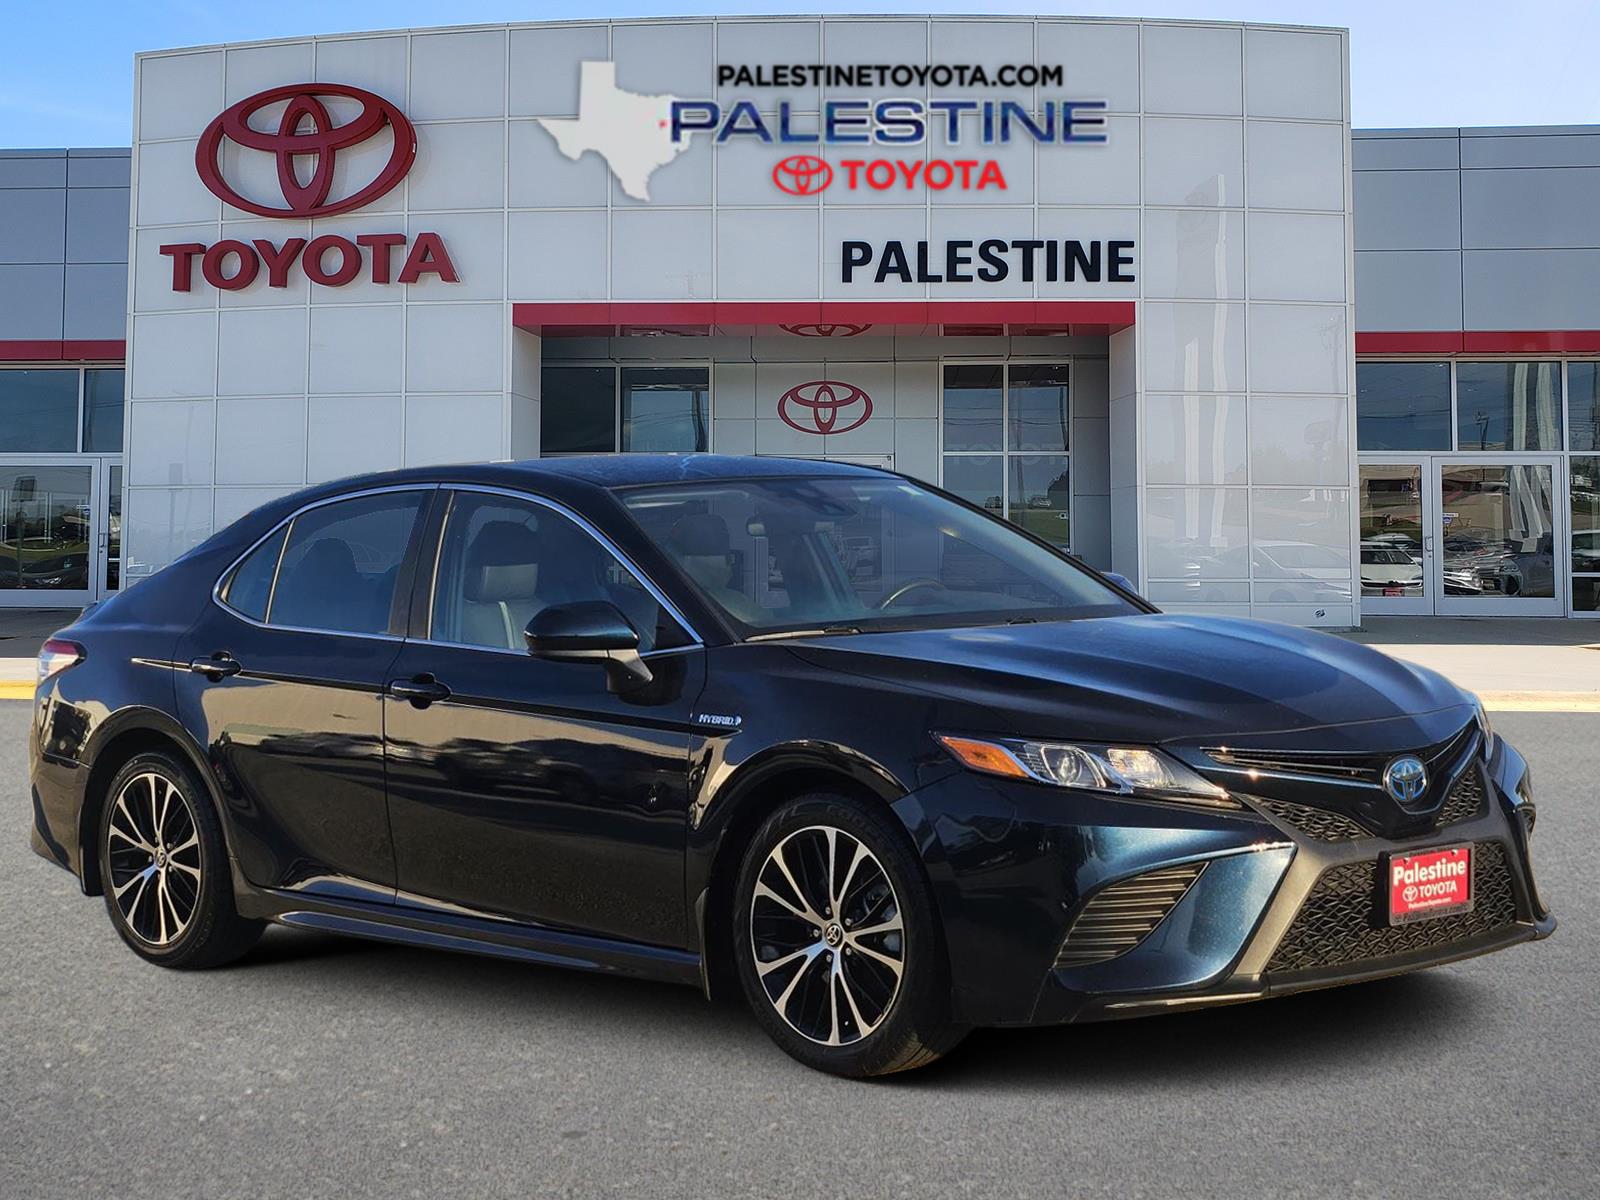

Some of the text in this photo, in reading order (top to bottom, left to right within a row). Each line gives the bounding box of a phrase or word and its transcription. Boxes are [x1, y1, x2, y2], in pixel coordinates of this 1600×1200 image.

[160, 232, 461, 292] TOYOTA
[841, 239, 1136, 283] PALESTINE
[699, 713, 734, 726] HYBRID
[1393, 858, 1466, 887] Palestine
[1419, 880, 1457, 898] TOYOTA
